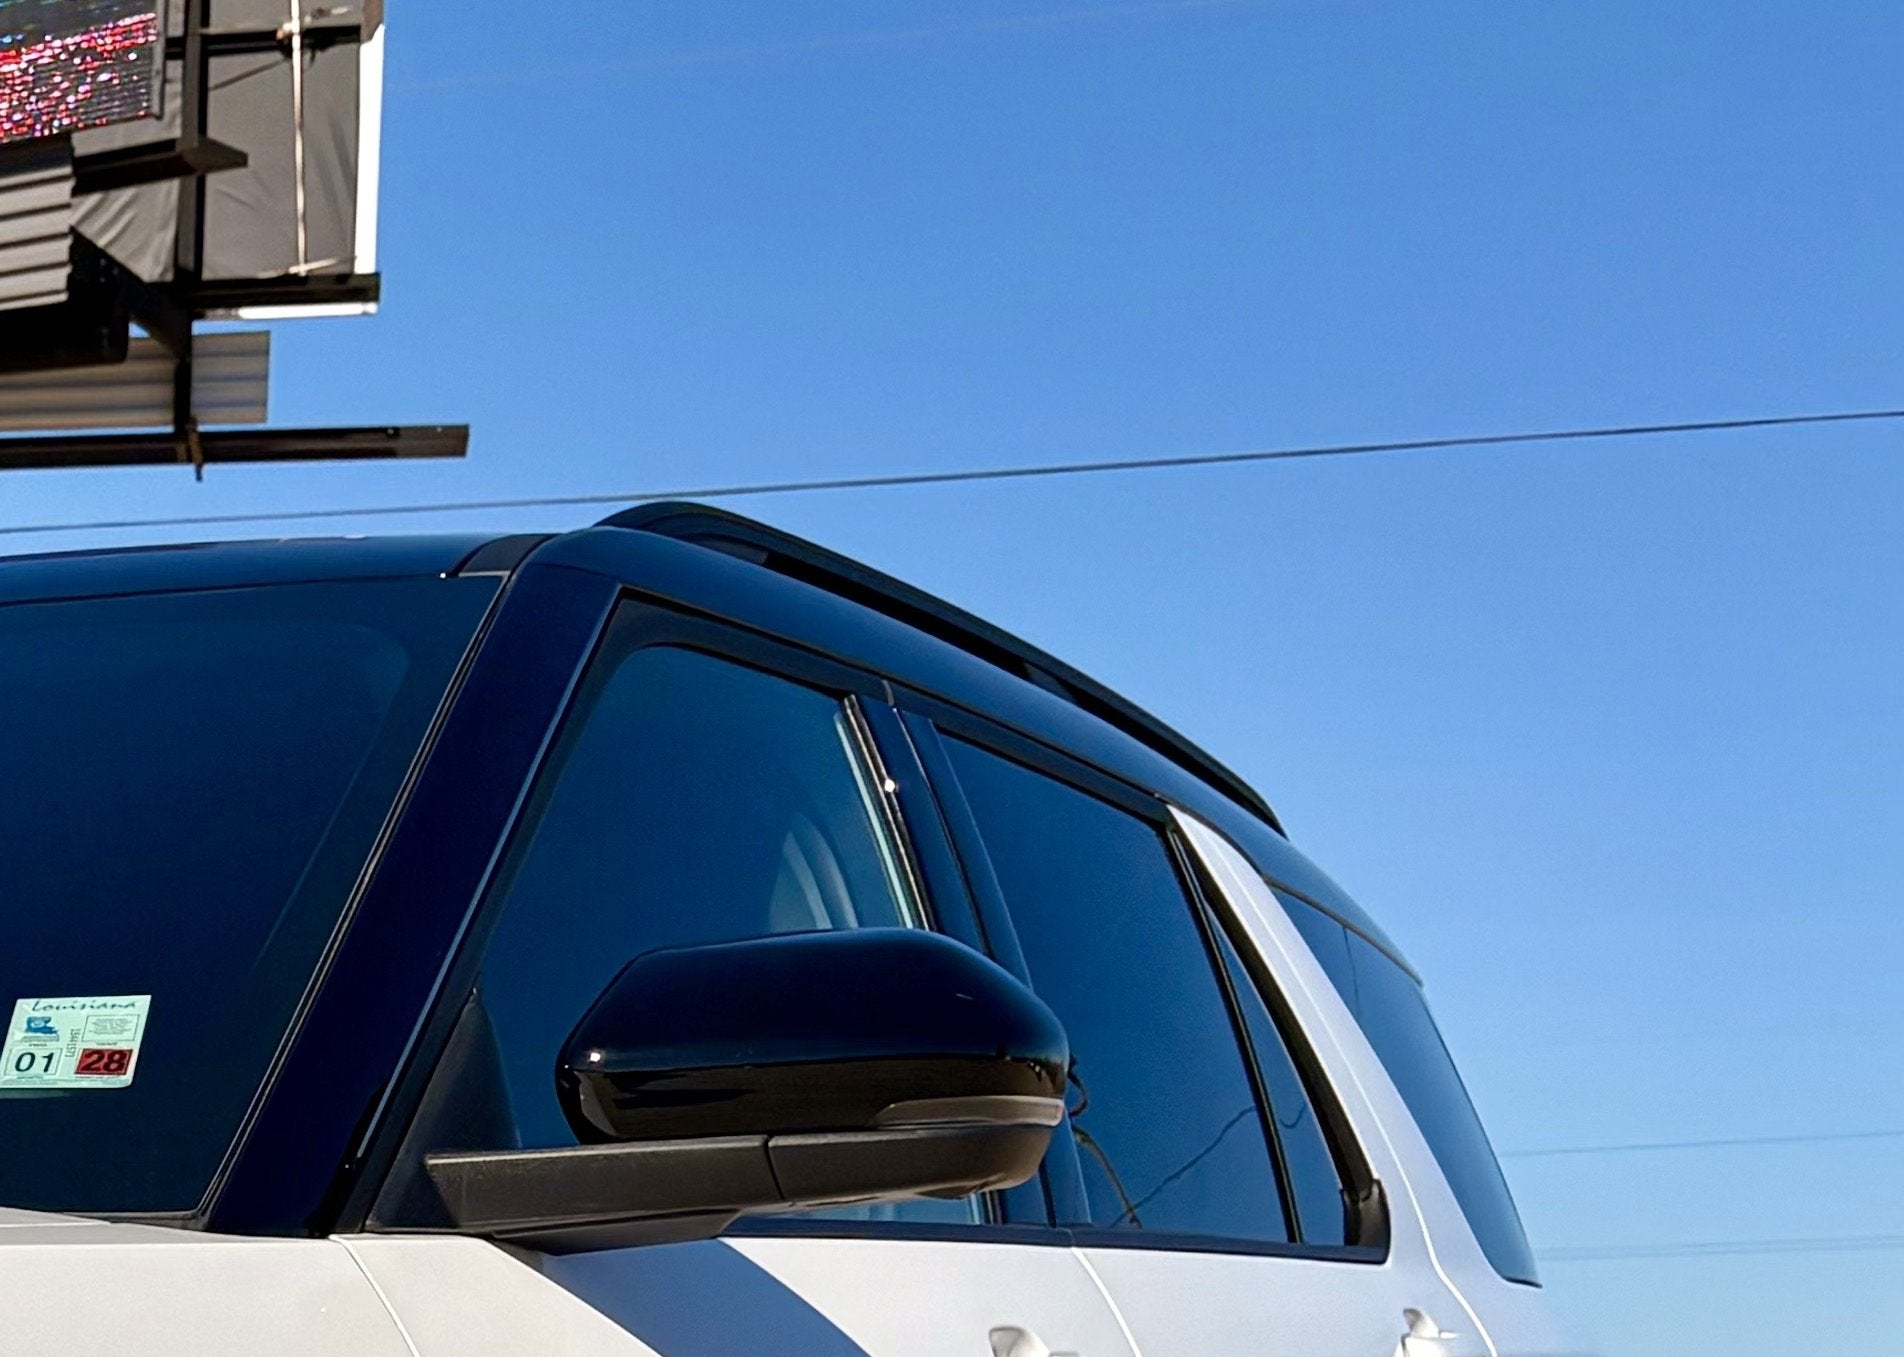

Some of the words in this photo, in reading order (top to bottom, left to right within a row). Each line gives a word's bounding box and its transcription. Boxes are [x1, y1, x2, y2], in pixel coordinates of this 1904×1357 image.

[32, 1000, 136, 1012] Louisiana
[15, 1052, 55, 1073] 01
[79, 1050, 127, 1073] 28
